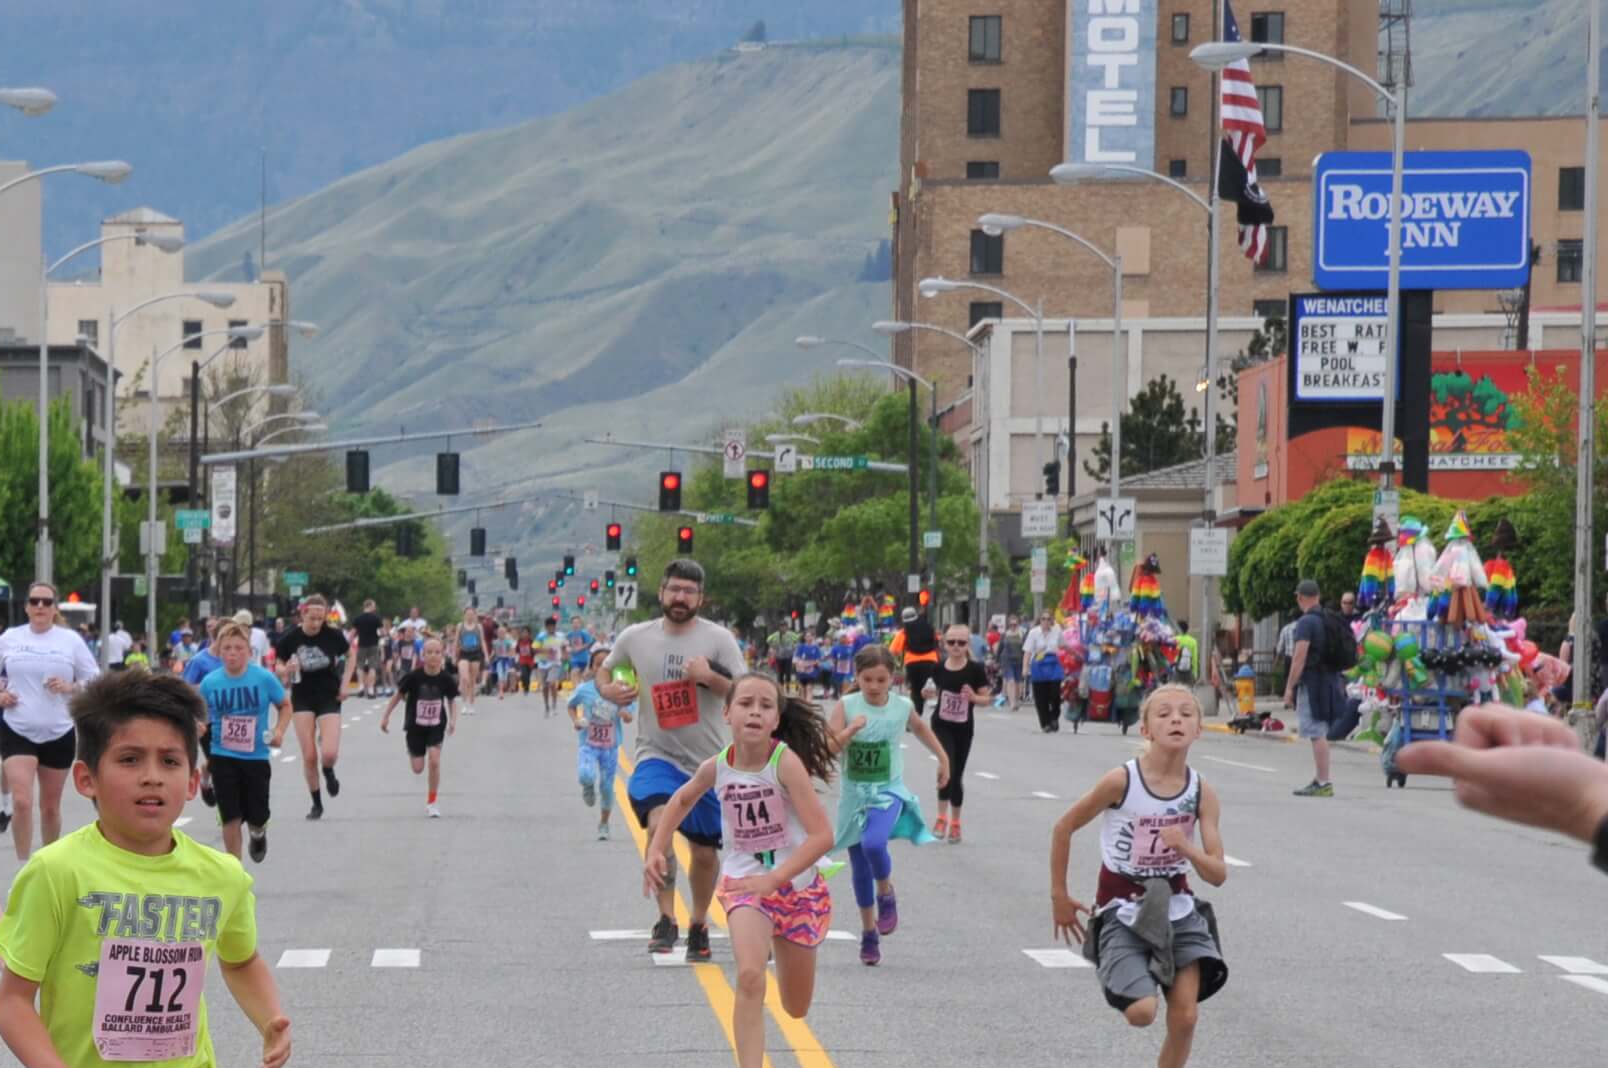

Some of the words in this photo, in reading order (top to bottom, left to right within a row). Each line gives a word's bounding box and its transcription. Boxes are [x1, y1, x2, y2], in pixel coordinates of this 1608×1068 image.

[1328, 184, 1519, 220] RODEWAY
[1303, 297, 1388, 313] WENATCHE
[1301, 324, 1336, 338] BEST
[1355, 324, 1388, 338] RAT
[1302, 341, 1336, 354] FREE
[1321, 357, 1355, 370] POOL
[1303, 373, 1386, 387] BREAKFAS
[815, 456, 853, 469] SECOND
[214, 686, 260, 711] WIN
[656, 690, 691, 711] 1368
[228, 722, 248, 737] 526
[855, 750, 880, 766] 247
[733, 800, 770, 827] 744
[89, 892, 223, 940] FASTER
[109, 944, 140, 961] APPLE
[143, 947, 187, 963] BLOSSOM
[188, 947, 203, 962] RUN
[125, 966, 187, 1013] 712
[104, 1014, 163, 1025] CONFLUENCE
[165, 1013, 191, 1025] HEALTH
[101, 1022, 143, 1033] BALLARD
[145, 1022, 191, 1034] AMBULANCE
